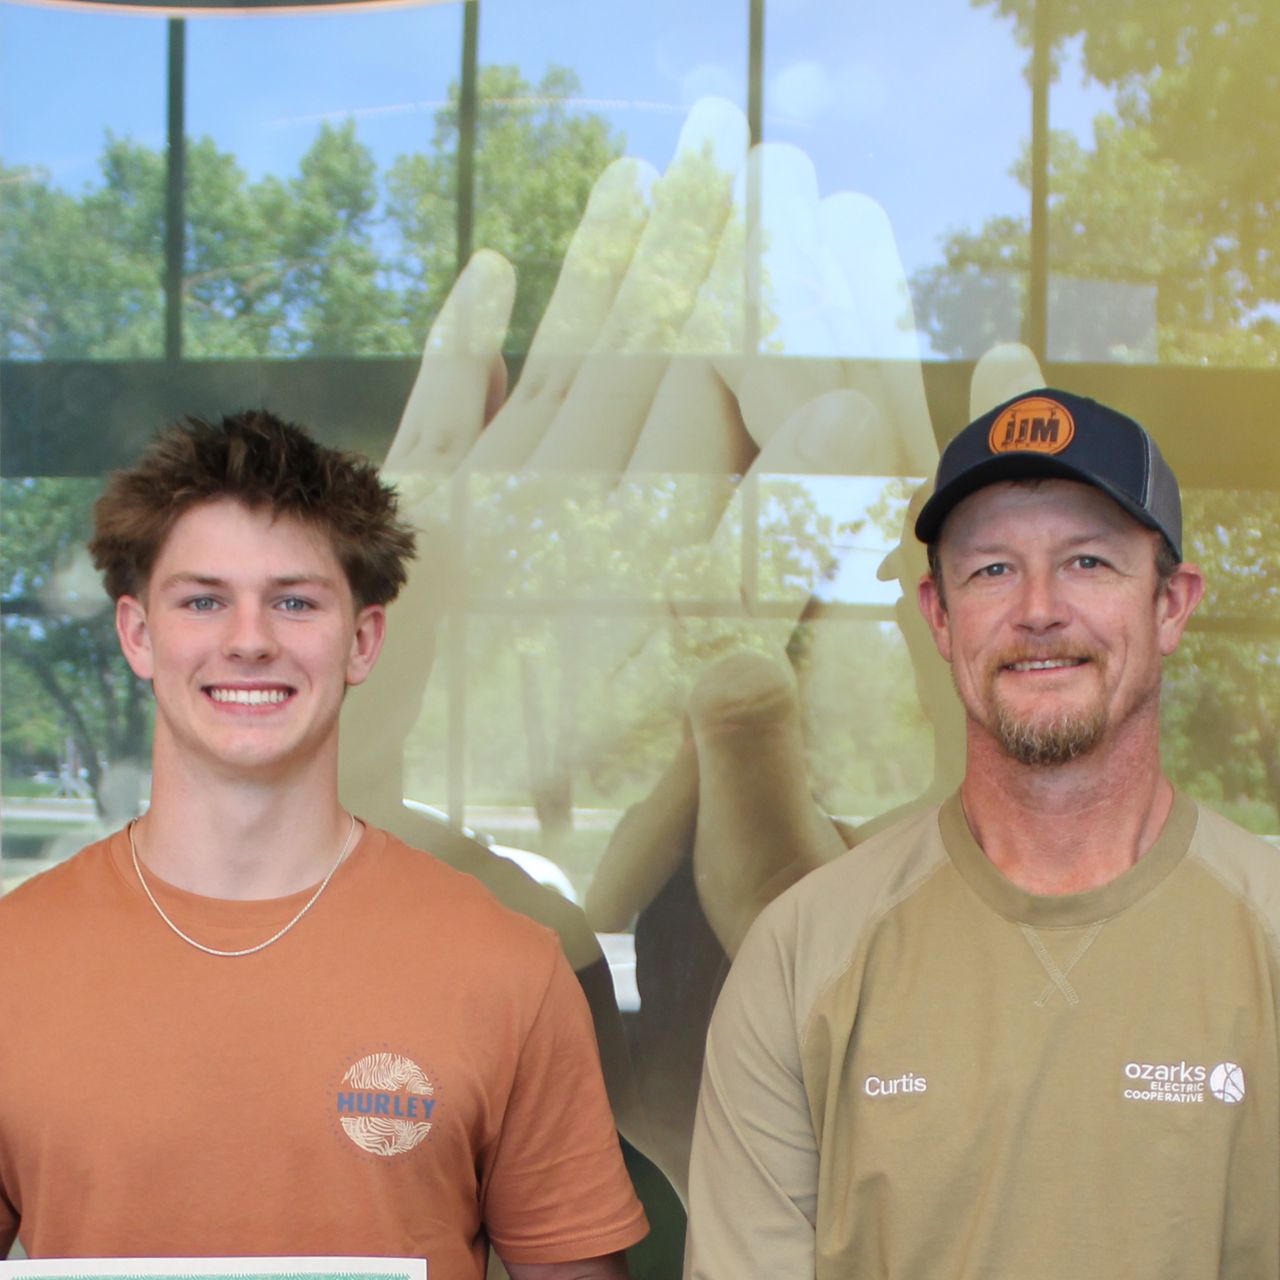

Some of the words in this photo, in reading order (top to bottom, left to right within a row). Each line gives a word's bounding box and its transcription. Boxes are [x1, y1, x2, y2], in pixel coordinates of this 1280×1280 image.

[1125, 1061, 1206, 1081] ozarks
[864, 1072, 927, 1096] Curtis
[1150, 1081, 1204, 1092] ELECTRIC
[337, 1092, 437, 1119] HURLEY
[1124, 1089, 1204, 1103] COOPERATIVE
